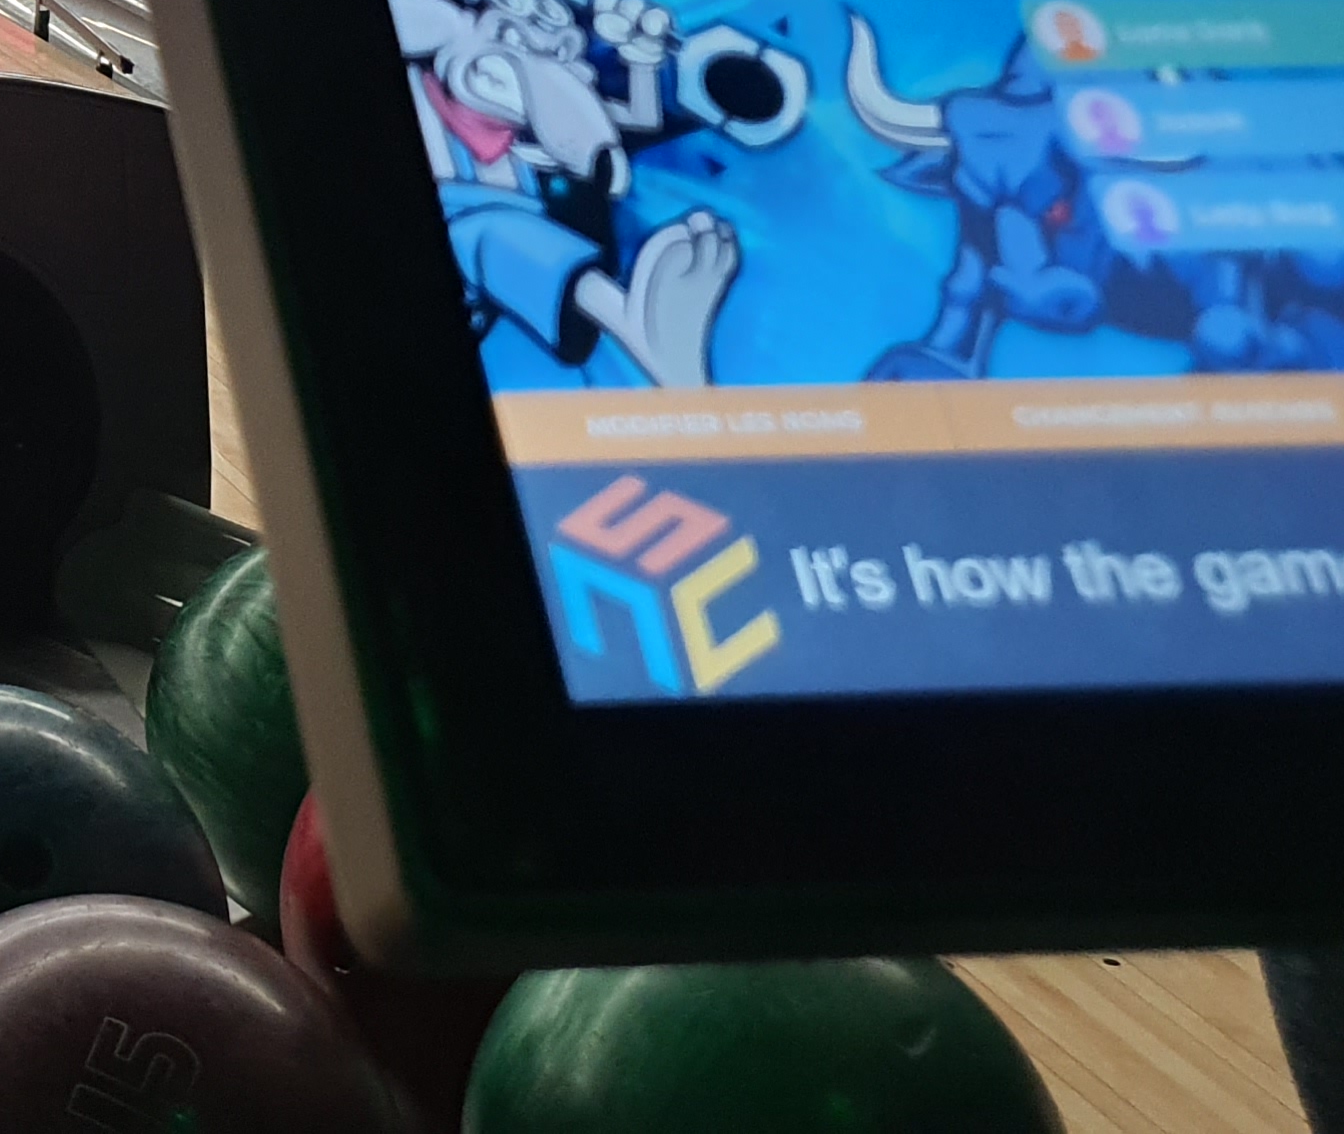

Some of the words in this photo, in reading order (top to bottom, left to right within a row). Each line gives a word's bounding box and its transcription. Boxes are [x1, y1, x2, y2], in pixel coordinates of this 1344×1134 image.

[790, 543, 898, 611] It's
[902, 541, 1053, 606] how
[1062, 539, 1184, 603] the
